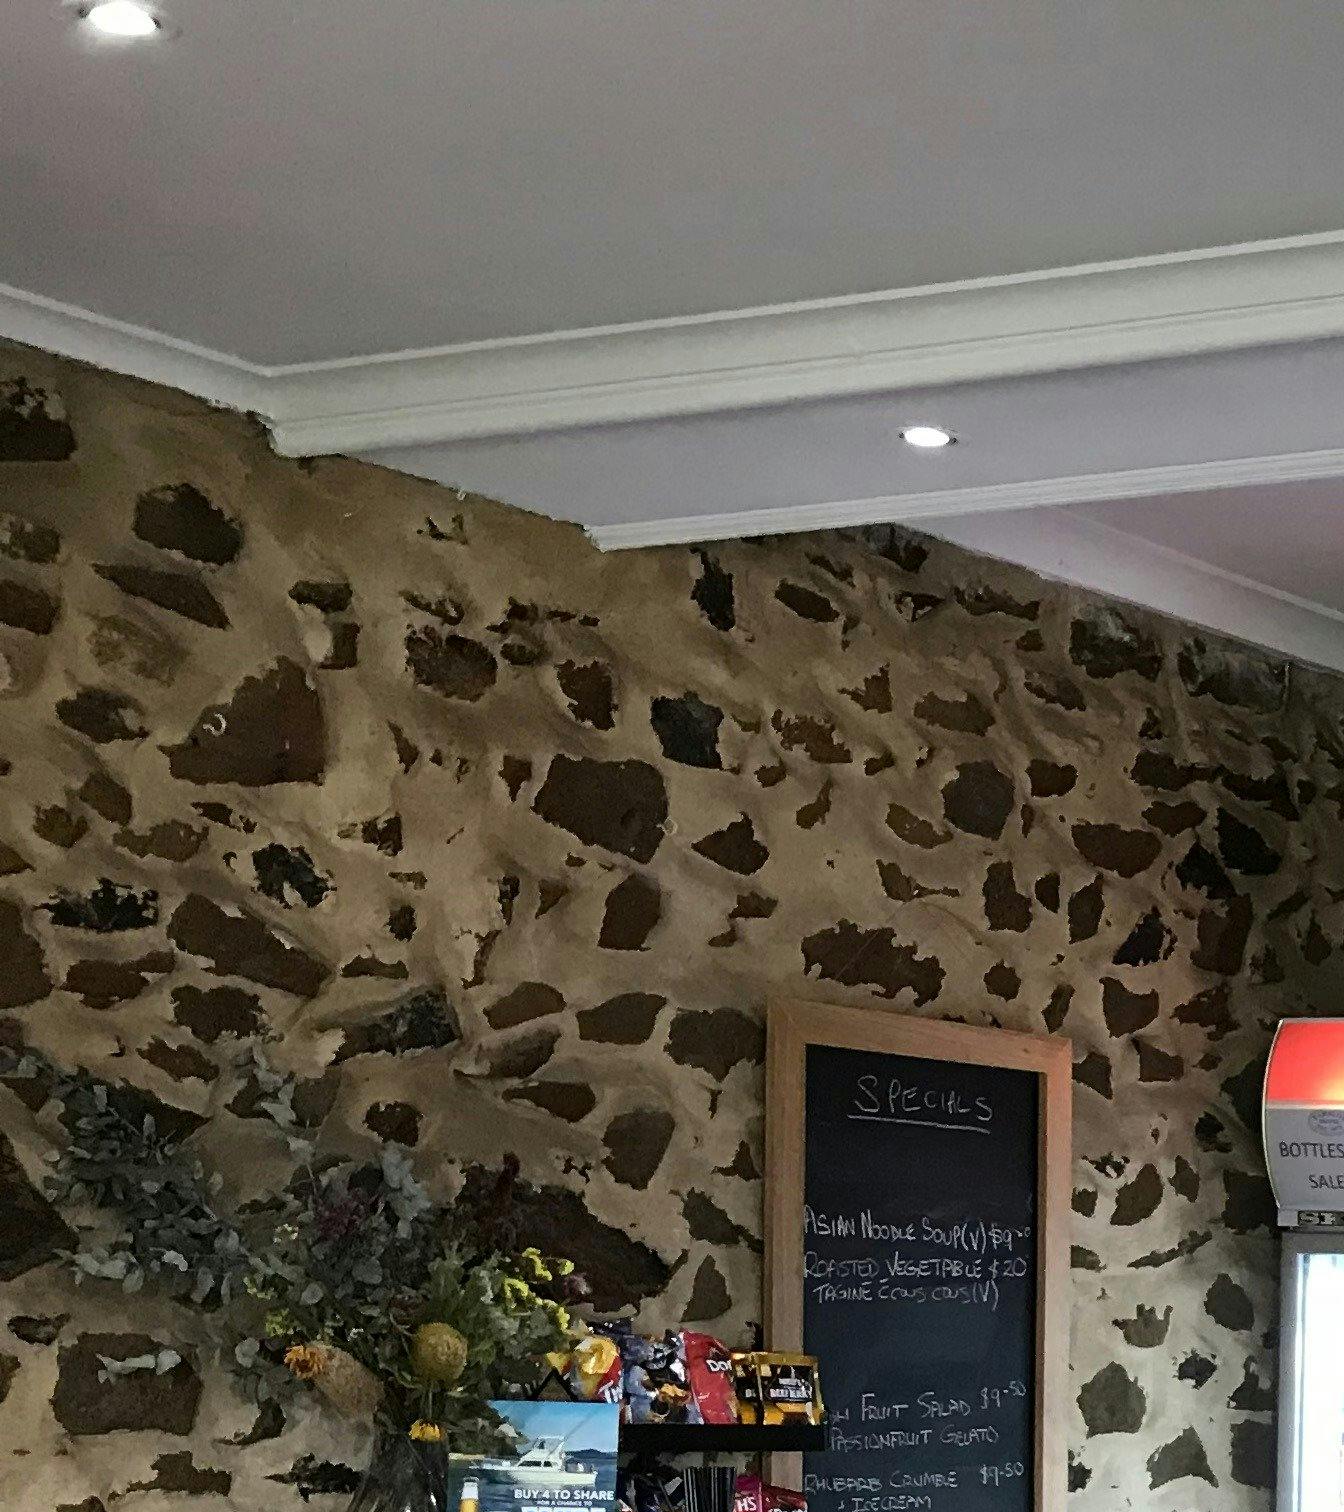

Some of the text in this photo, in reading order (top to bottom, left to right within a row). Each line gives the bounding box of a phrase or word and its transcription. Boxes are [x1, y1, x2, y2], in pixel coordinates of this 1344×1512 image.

[854, 1075, 993, 1121] SPECIALS
[514, 1489, 615, 1500] BUY 4 TO SHARE
